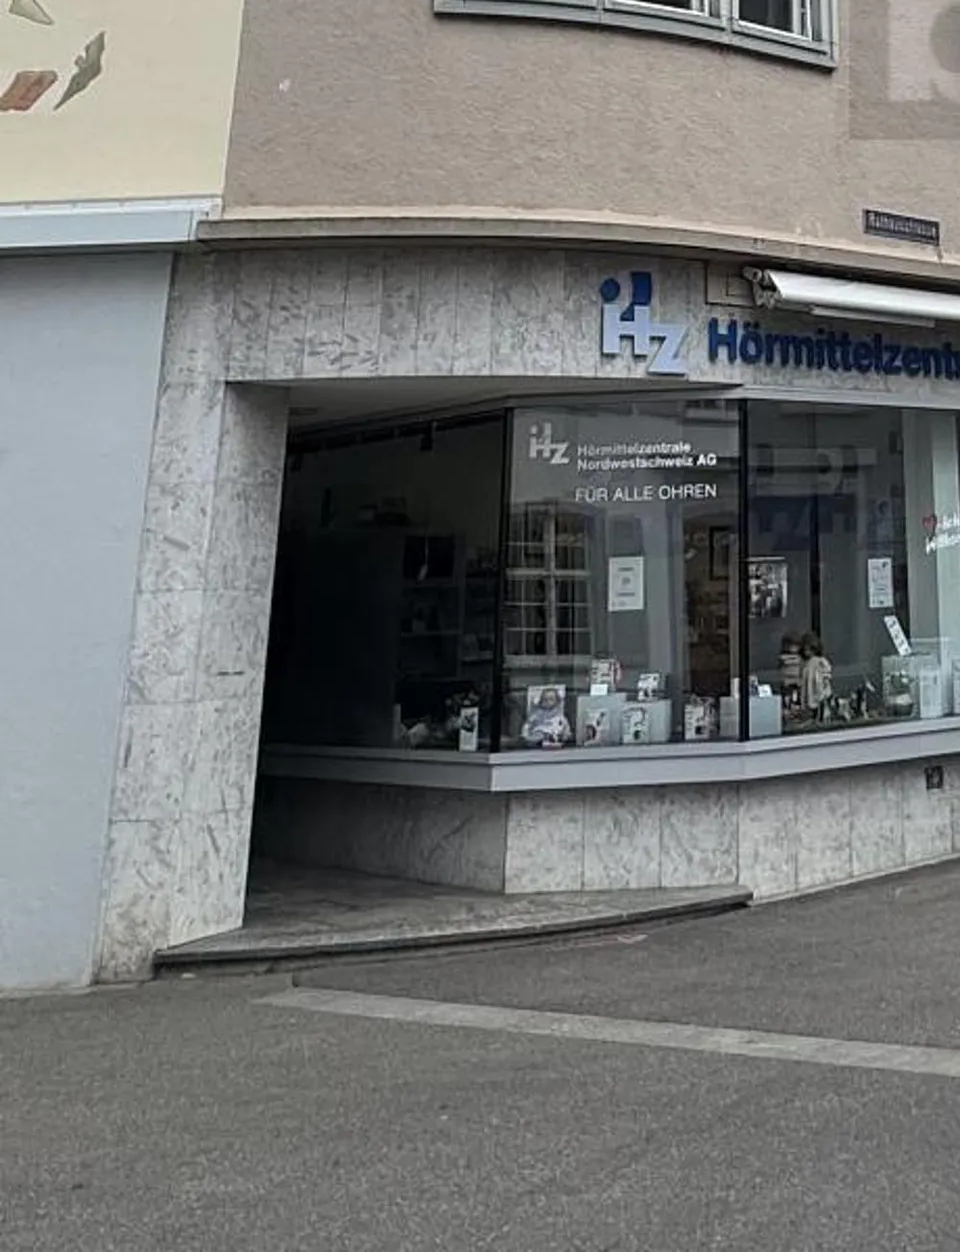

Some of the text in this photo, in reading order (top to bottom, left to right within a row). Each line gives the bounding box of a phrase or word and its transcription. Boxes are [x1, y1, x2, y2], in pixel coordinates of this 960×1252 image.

[577, 441, 692, 457] Hörmittelzentrale
[577, 453, 717, 472] Nordwestschweiz AG
[575, 483, 717, 503] FÜR ALLE OHREN
